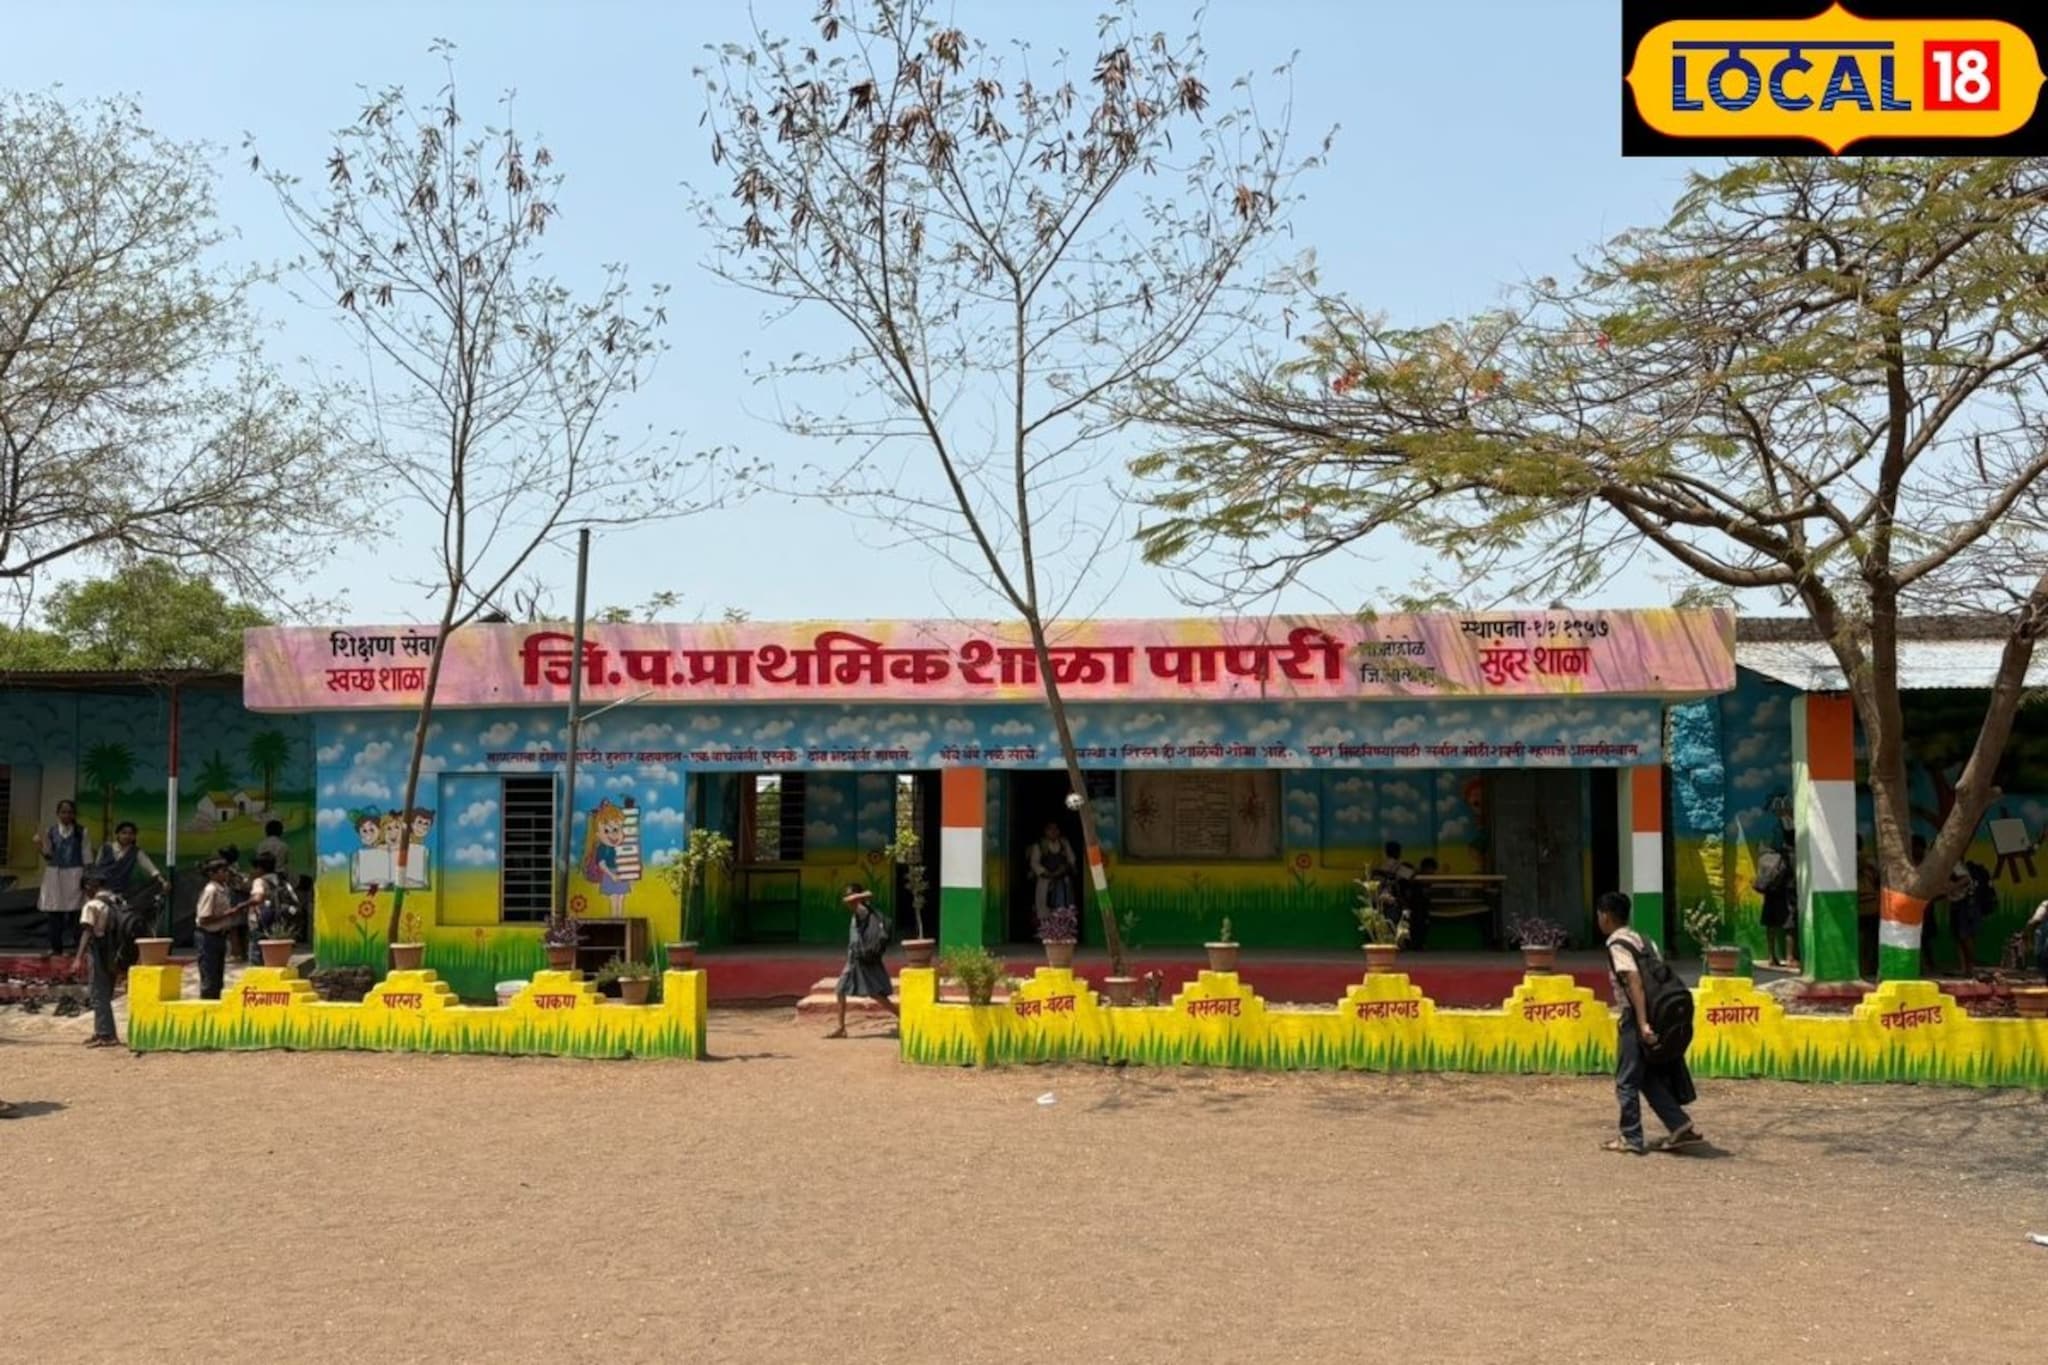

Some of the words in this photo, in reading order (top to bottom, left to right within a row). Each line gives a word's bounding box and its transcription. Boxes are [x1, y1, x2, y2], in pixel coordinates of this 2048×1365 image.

[330, 630, 395, 662] शिक्षण
[1146, 627, 1345, 683] पापरी
[1479, 639, 1529, 686] सुंदर
[1534, 647, 1590, 674] शाळा
[326, 667, 376, 692] स्वच्छ
[378, 667, 426, 692] शाळा
[533, 994, 577, 1009] चाकण
[1880, 1002, 1942, 1030] वर्धनगड
